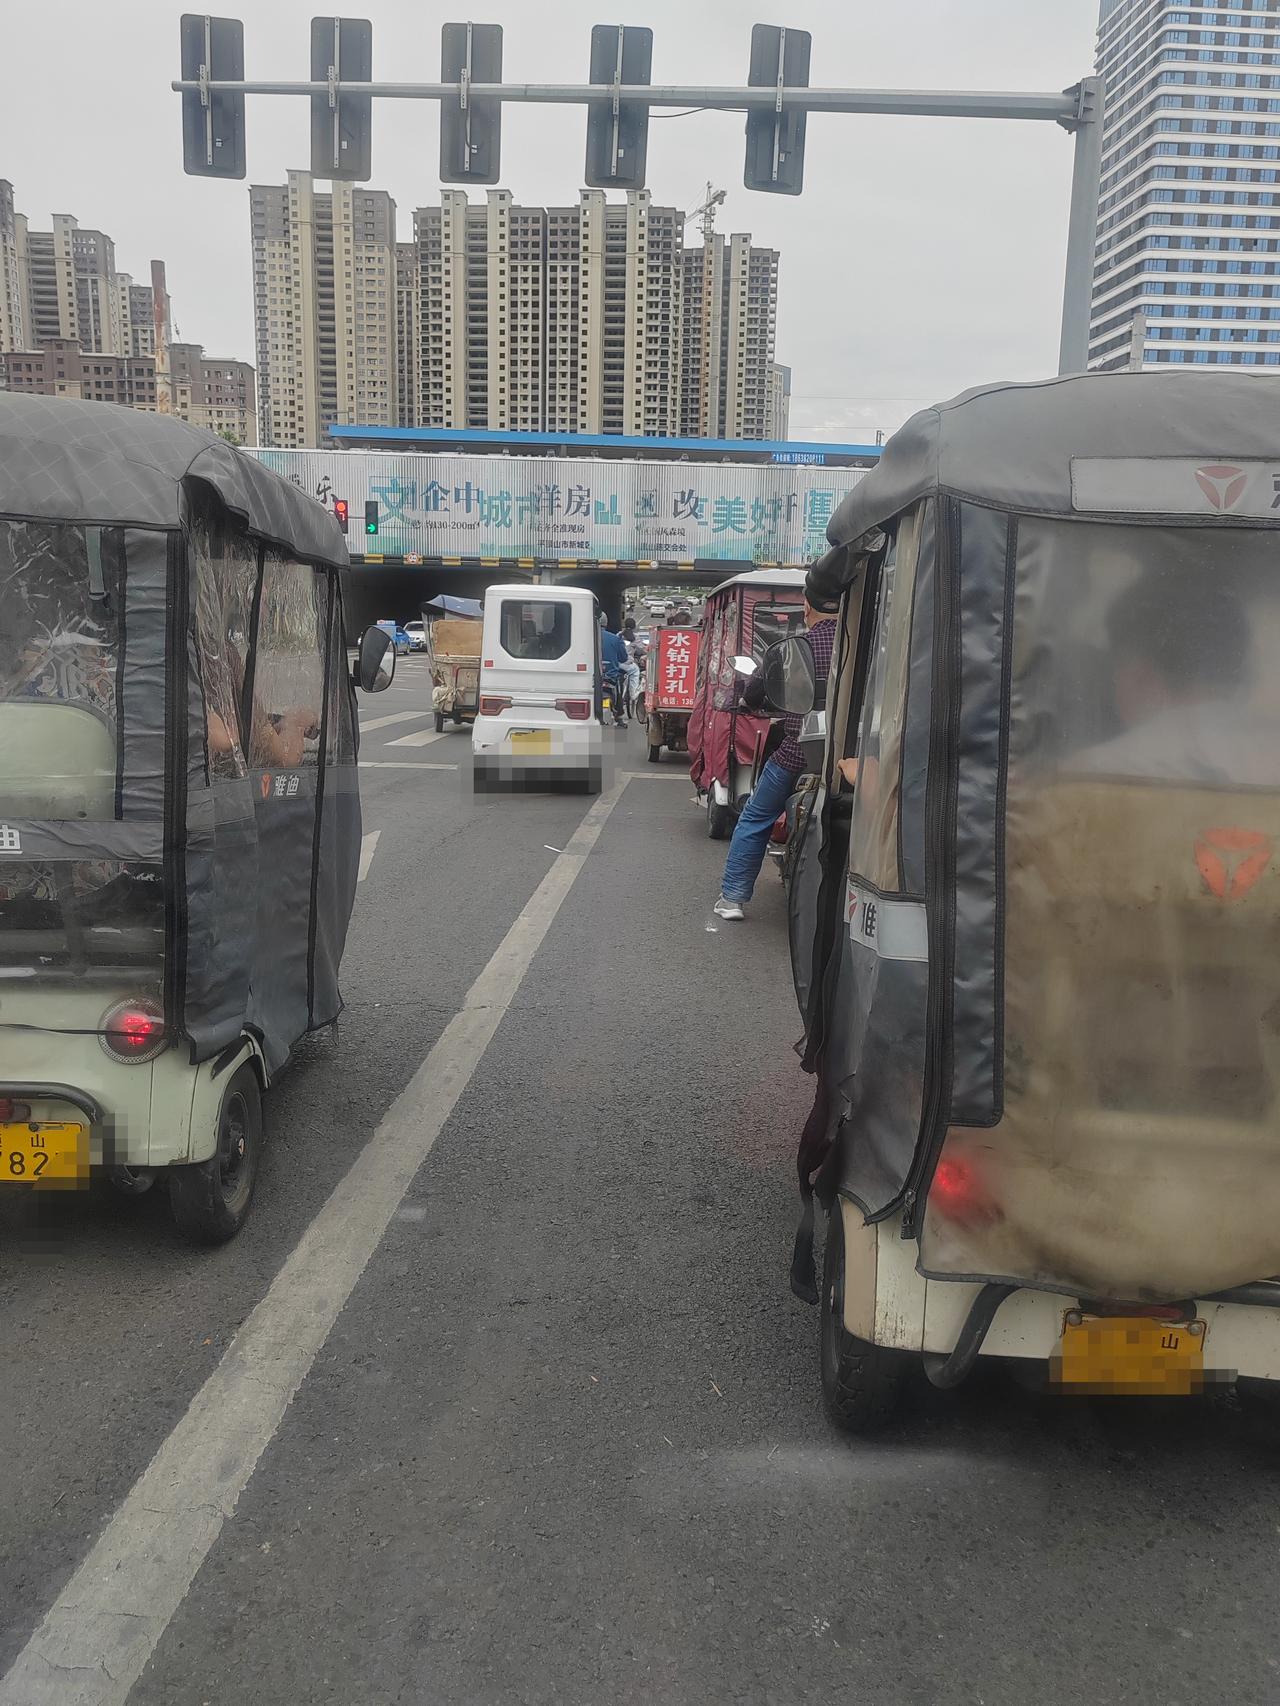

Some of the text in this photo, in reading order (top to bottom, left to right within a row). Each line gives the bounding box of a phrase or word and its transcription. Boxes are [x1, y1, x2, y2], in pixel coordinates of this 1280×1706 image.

[664, 632, 691, 694] 水钻打孔
[273, 774, 300, 797] 雅迪
[30, 1133, 45, 1148] 山
[1161, 1333, 1179, 1350] 山
